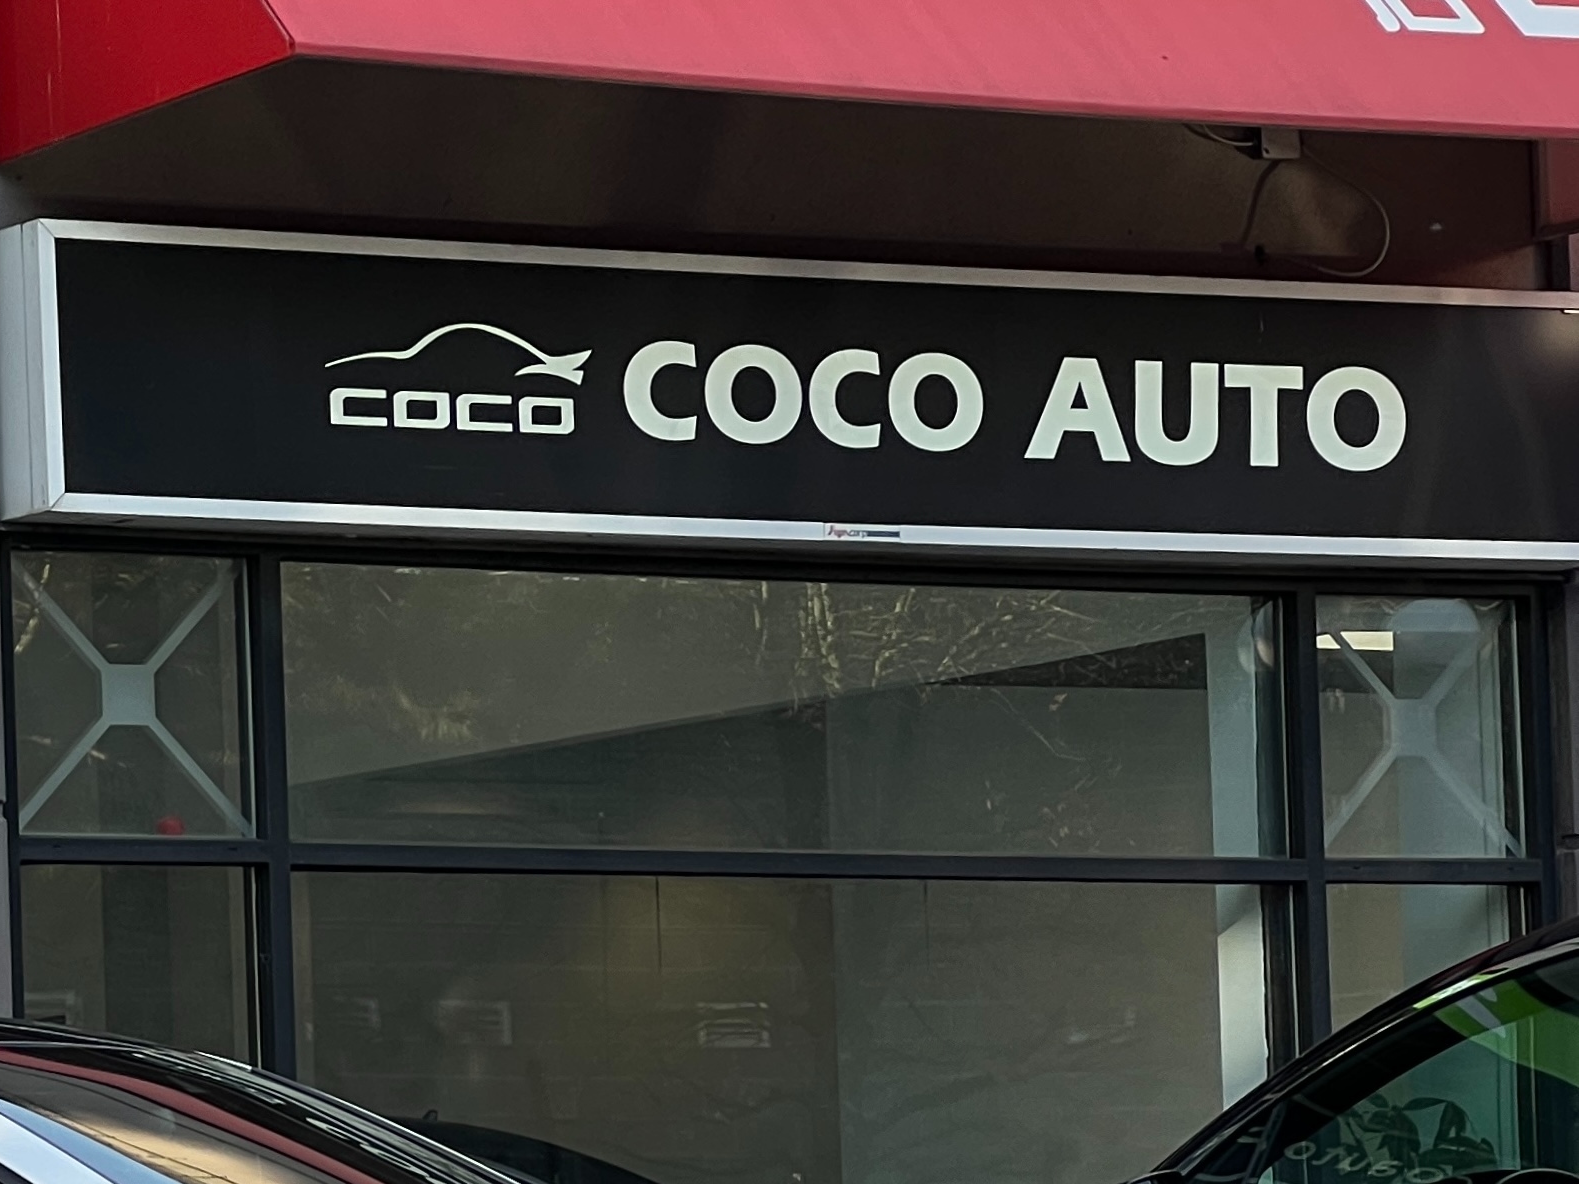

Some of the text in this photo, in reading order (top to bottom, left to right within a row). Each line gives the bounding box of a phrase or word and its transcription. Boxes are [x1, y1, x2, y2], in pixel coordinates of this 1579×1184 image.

[329, 386, 575, 436] COCO
[623, 340, 1407, 472] COCO AUTO
